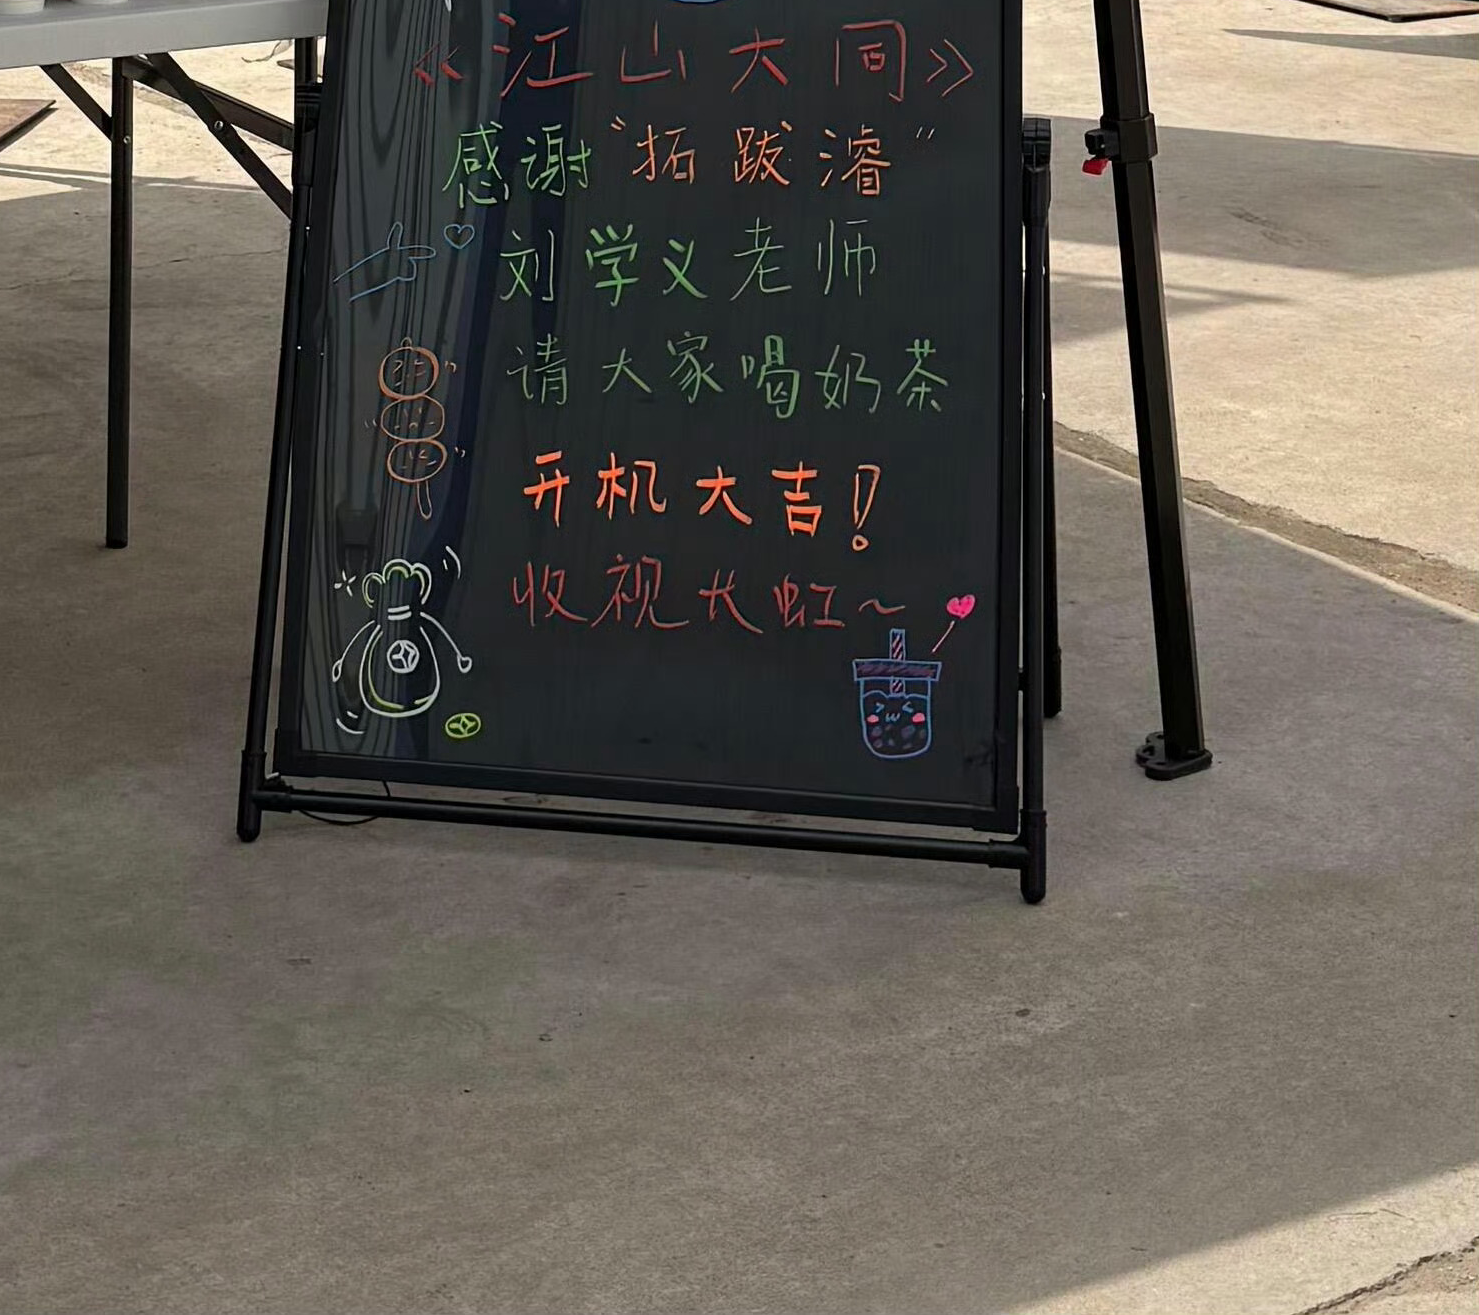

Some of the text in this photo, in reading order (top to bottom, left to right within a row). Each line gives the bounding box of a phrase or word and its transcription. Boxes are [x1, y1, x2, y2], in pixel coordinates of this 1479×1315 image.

[414, 11, 976, 102] 《江山大同》
[498, 216, 880, 307] 刘学义老师
[506, 330, 951, 419] 请大家喝奶茶
